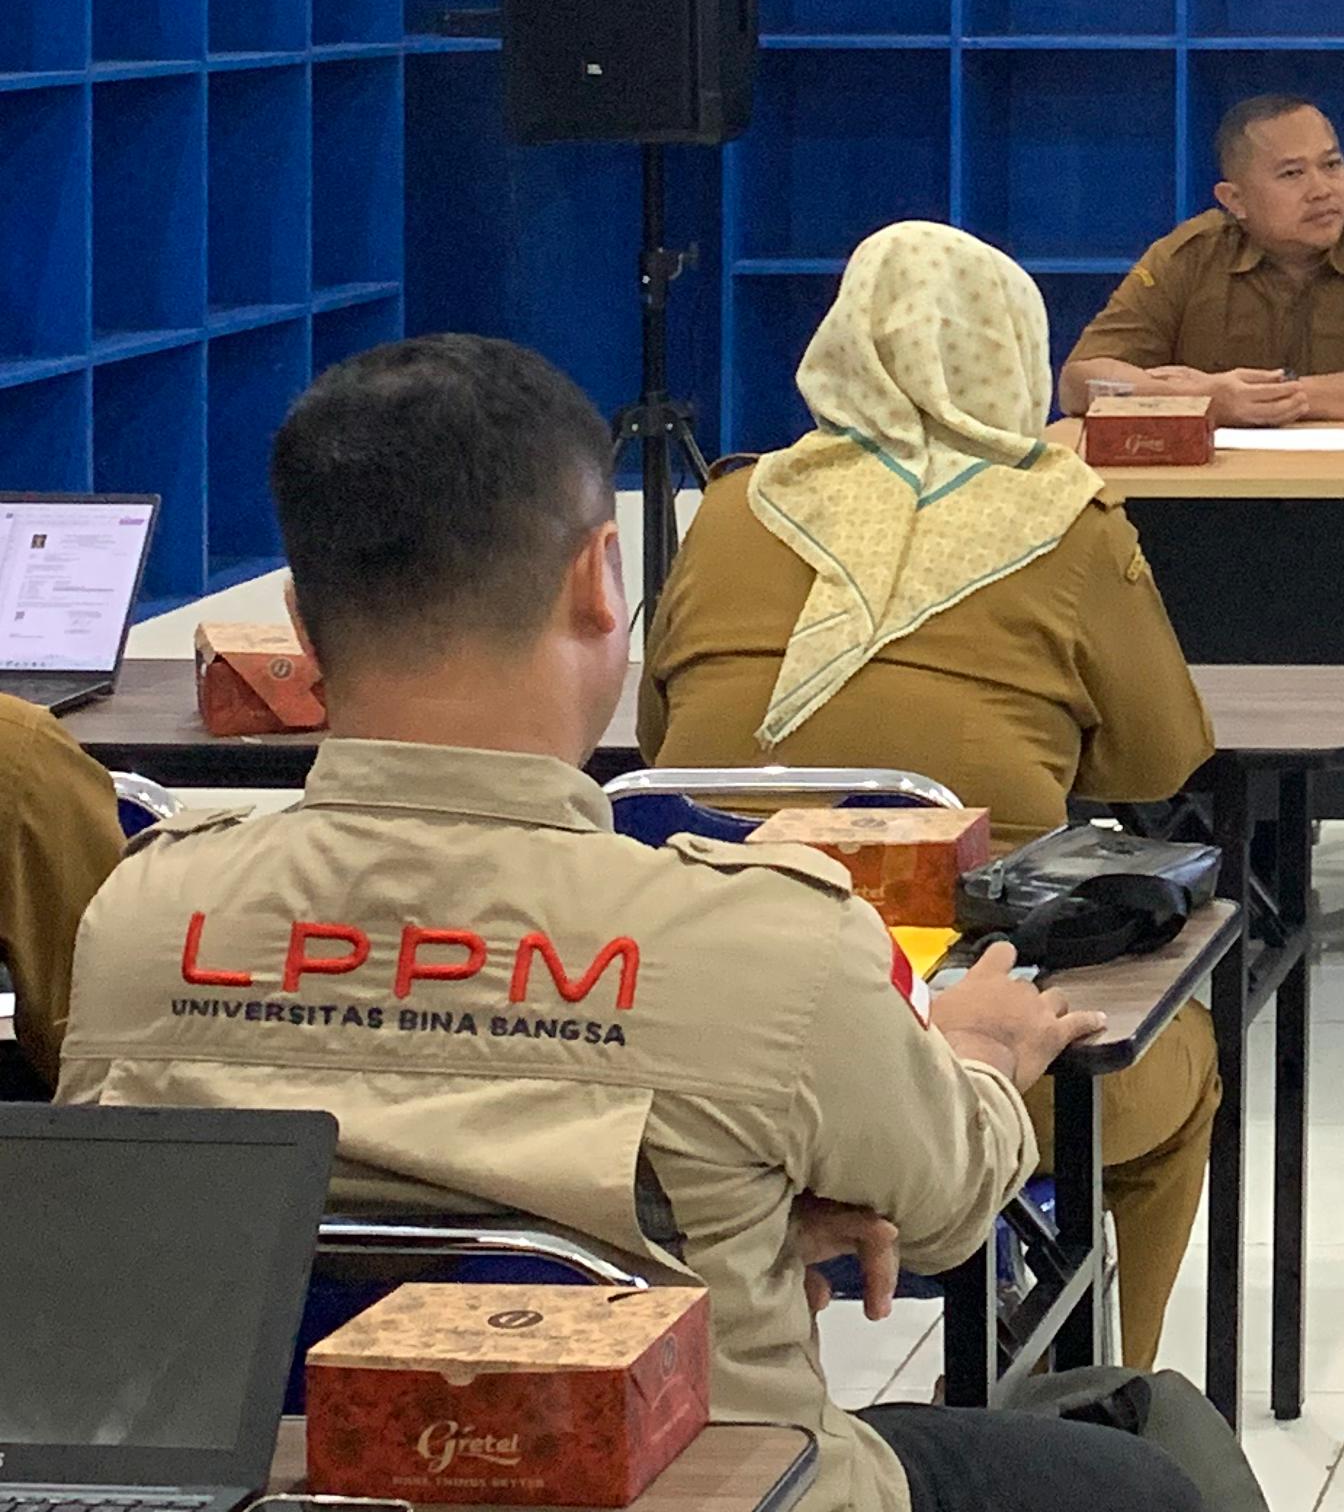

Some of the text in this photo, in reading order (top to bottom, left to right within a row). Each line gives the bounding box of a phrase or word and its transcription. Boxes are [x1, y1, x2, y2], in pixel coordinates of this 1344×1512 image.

[181, 911, 640, 1011] LPPM
[170, 998, 627, 1047] UNIVERSITAS BINA BANGSA
[416, 1420, 522, 1474] Gretel
